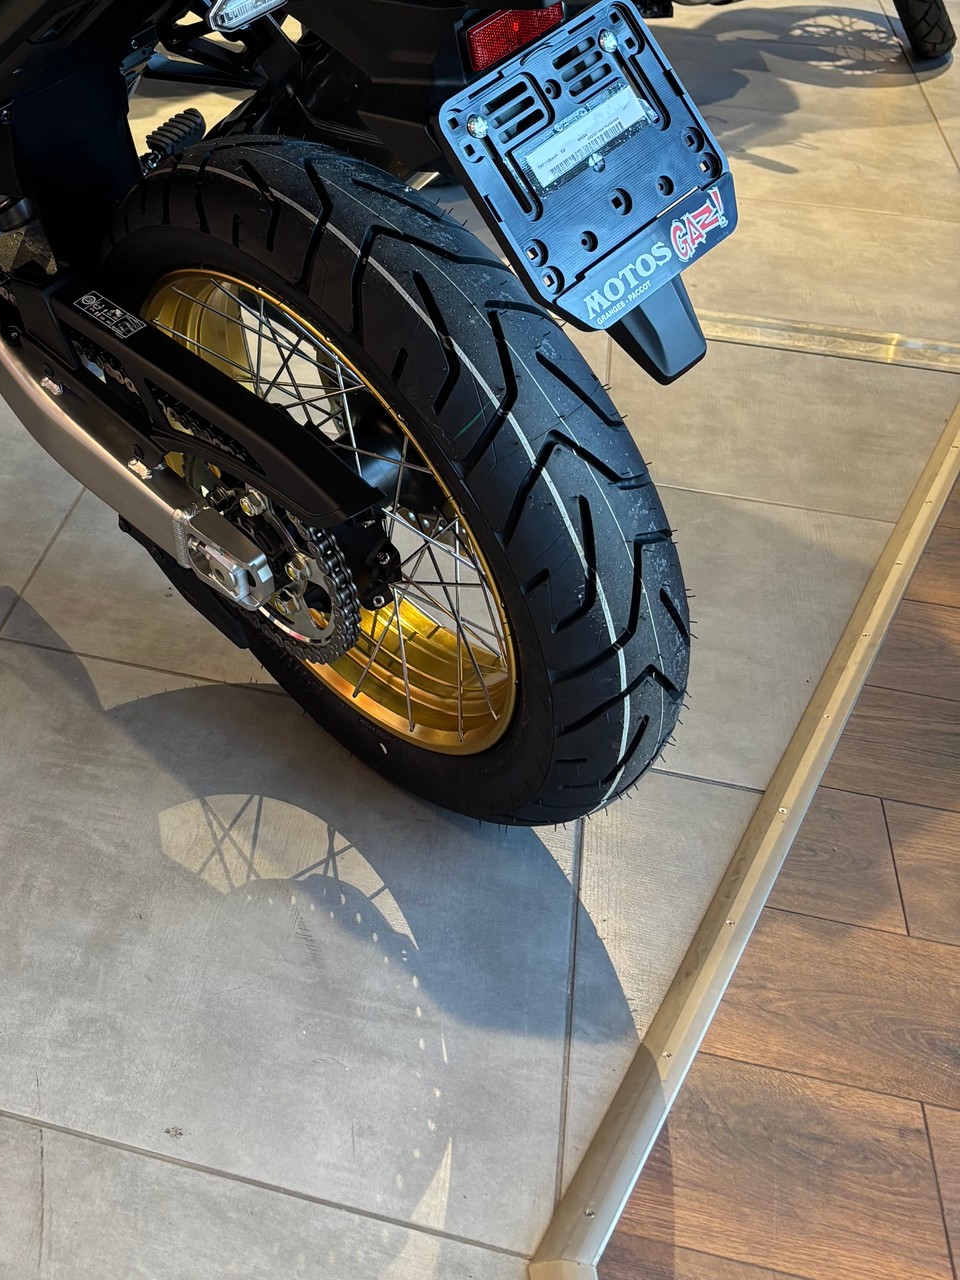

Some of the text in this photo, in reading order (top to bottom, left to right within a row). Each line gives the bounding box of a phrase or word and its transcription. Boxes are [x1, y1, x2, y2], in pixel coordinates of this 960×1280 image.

[583, 186, 729, 320] MOTOS GAZ!
[596, 300, 626, 325] GRANGES
[627, 280, 652, 302] PACCOT
